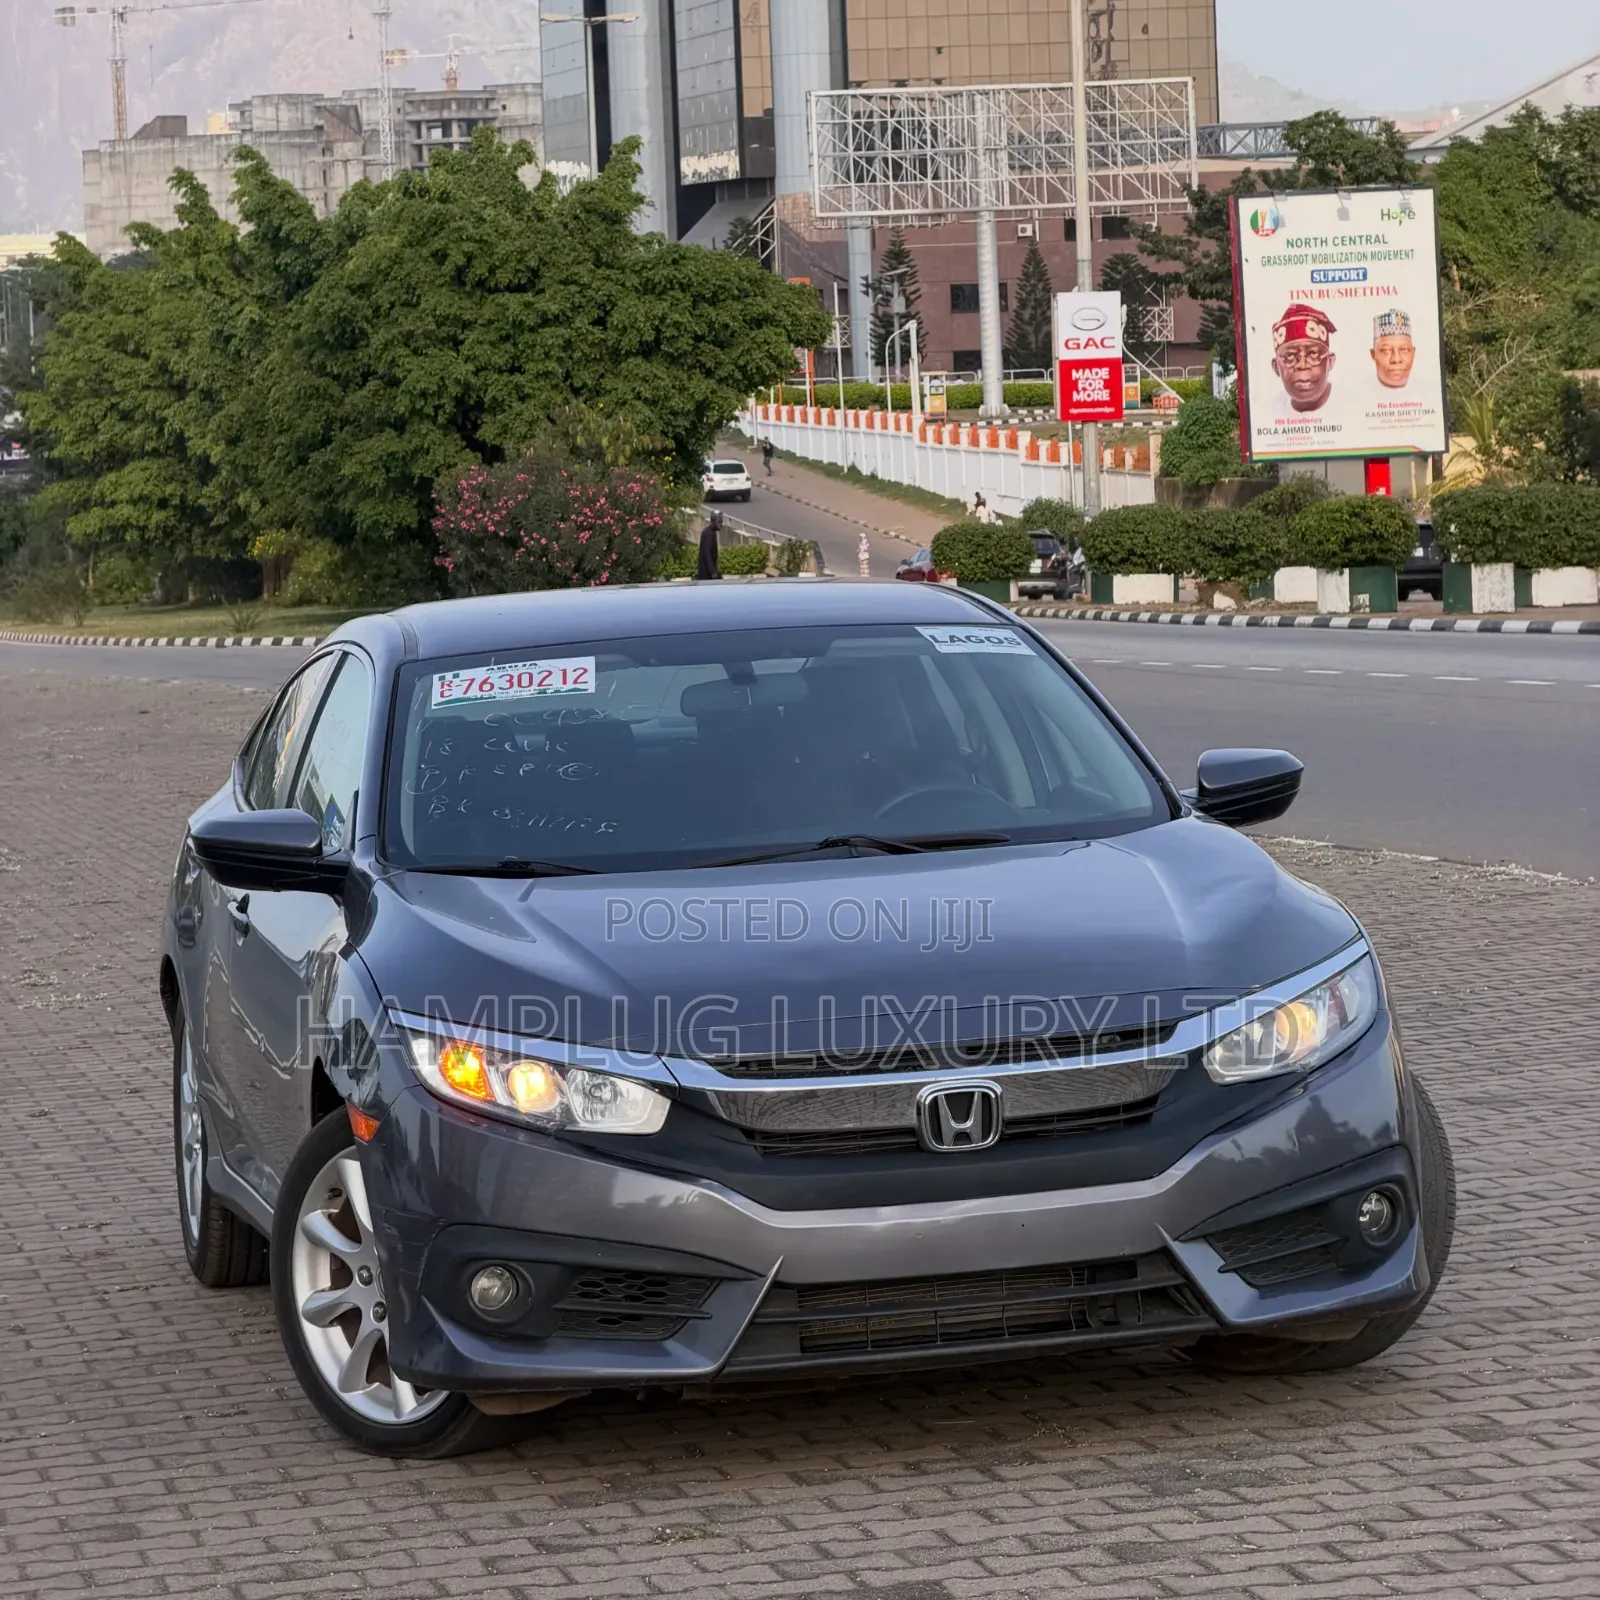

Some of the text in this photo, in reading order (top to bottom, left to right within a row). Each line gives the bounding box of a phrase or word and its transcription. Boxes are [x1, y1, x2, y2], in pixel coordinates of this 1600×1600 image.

[1380, 208, 1416, 226] Hope
[1286, 234, 1389, 249] NORTH CENTRAL
[1261, 249, 1415, 267] GRASSROOT MOBILIZATION MOVEMENT
[1312, 269, 1365, 282] SUPPORT
[1288, 285, 1398, 300] TINUBU/SHETTIMA
[1064, 336, 1116, 350] GAC
[1071, 367, 1110, 380] MADE
[1077, 379, 1104, 391] FOR
[1072, 389, 1111, 402] MORE
[1257, 424, 1343, 435] BOLA AHMED TINUBU
[928, 634, 1022, 646] LAGOS
